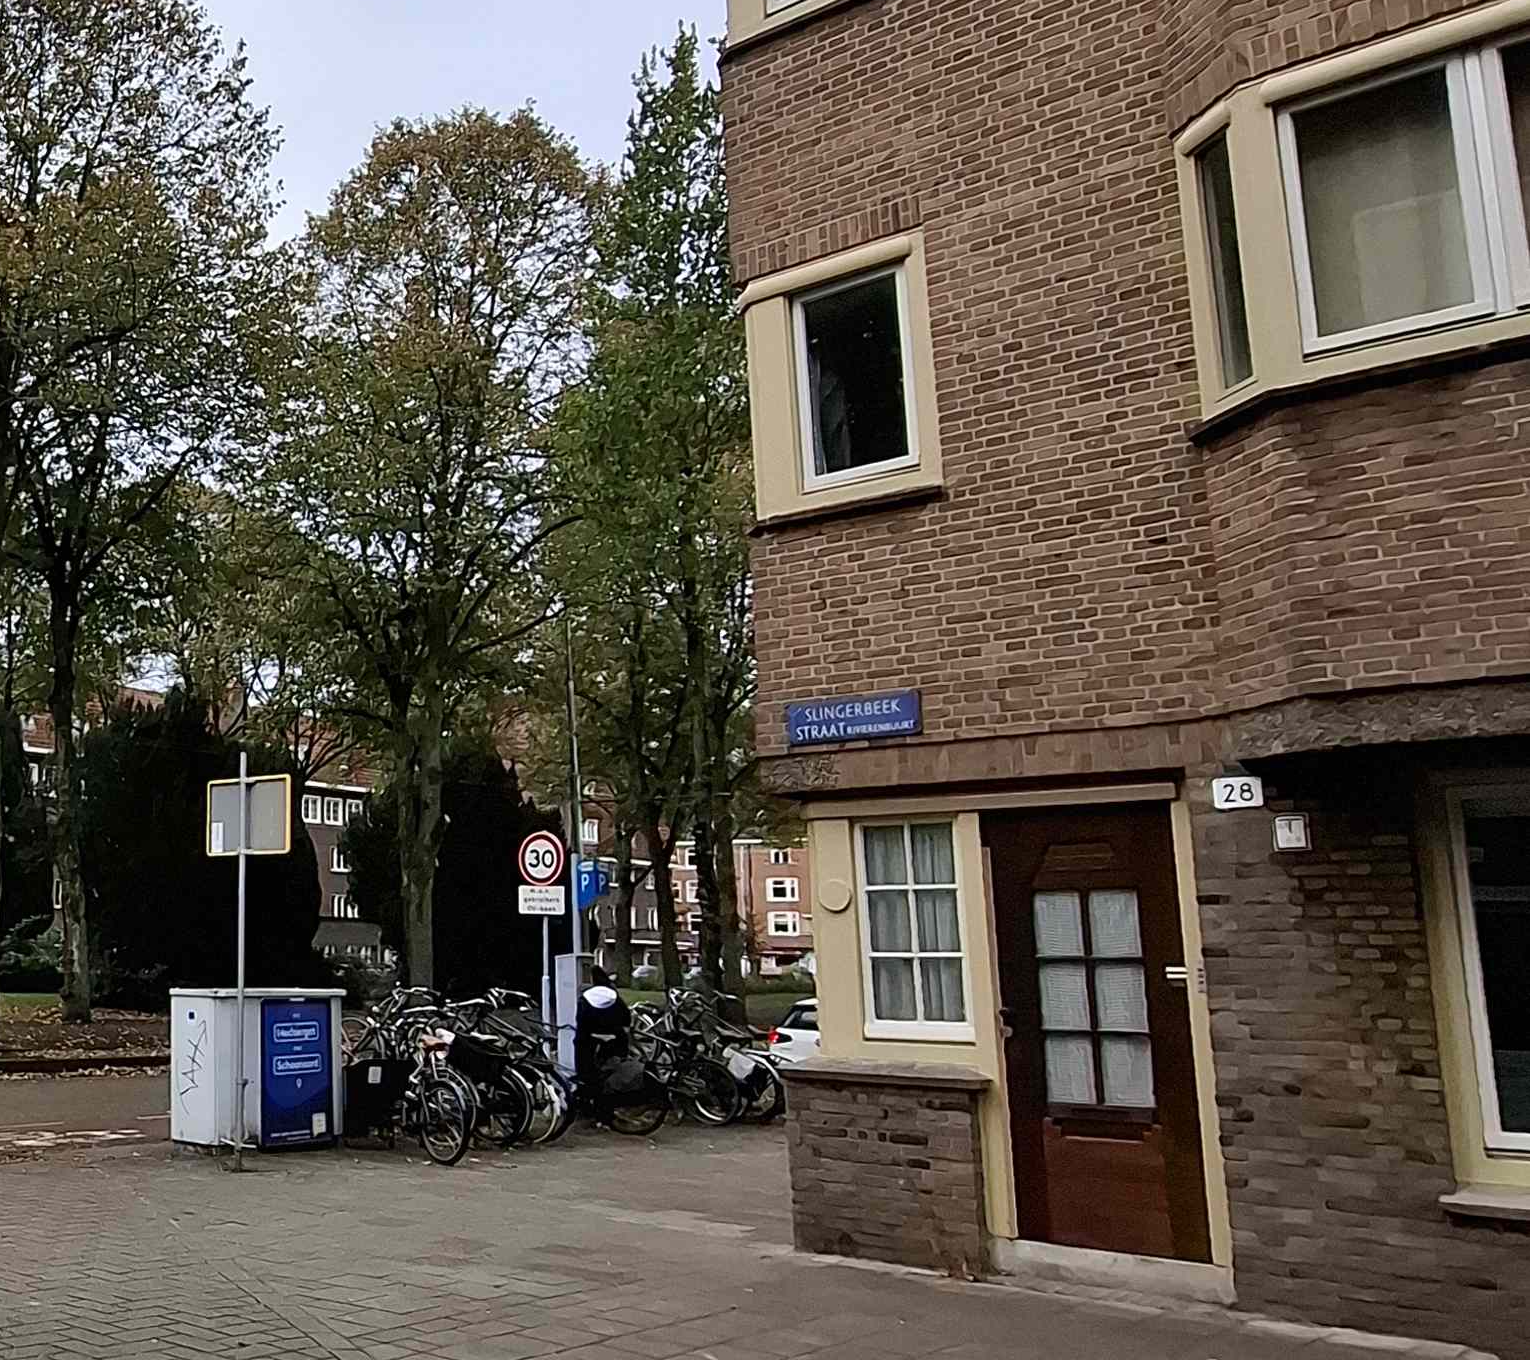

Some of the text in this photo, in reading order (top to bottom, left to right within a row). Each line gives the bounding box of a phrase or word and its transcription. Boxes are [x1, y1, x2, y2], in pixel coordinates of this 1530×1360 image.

[804, 698, 901, 722] SLINGERBEEK
[796, 721, 846, 741] STRAAT
[1222, 782, 1255, 803] 28
[528, 848, 555, 869] 30
[580, 872, 591, 893] P
